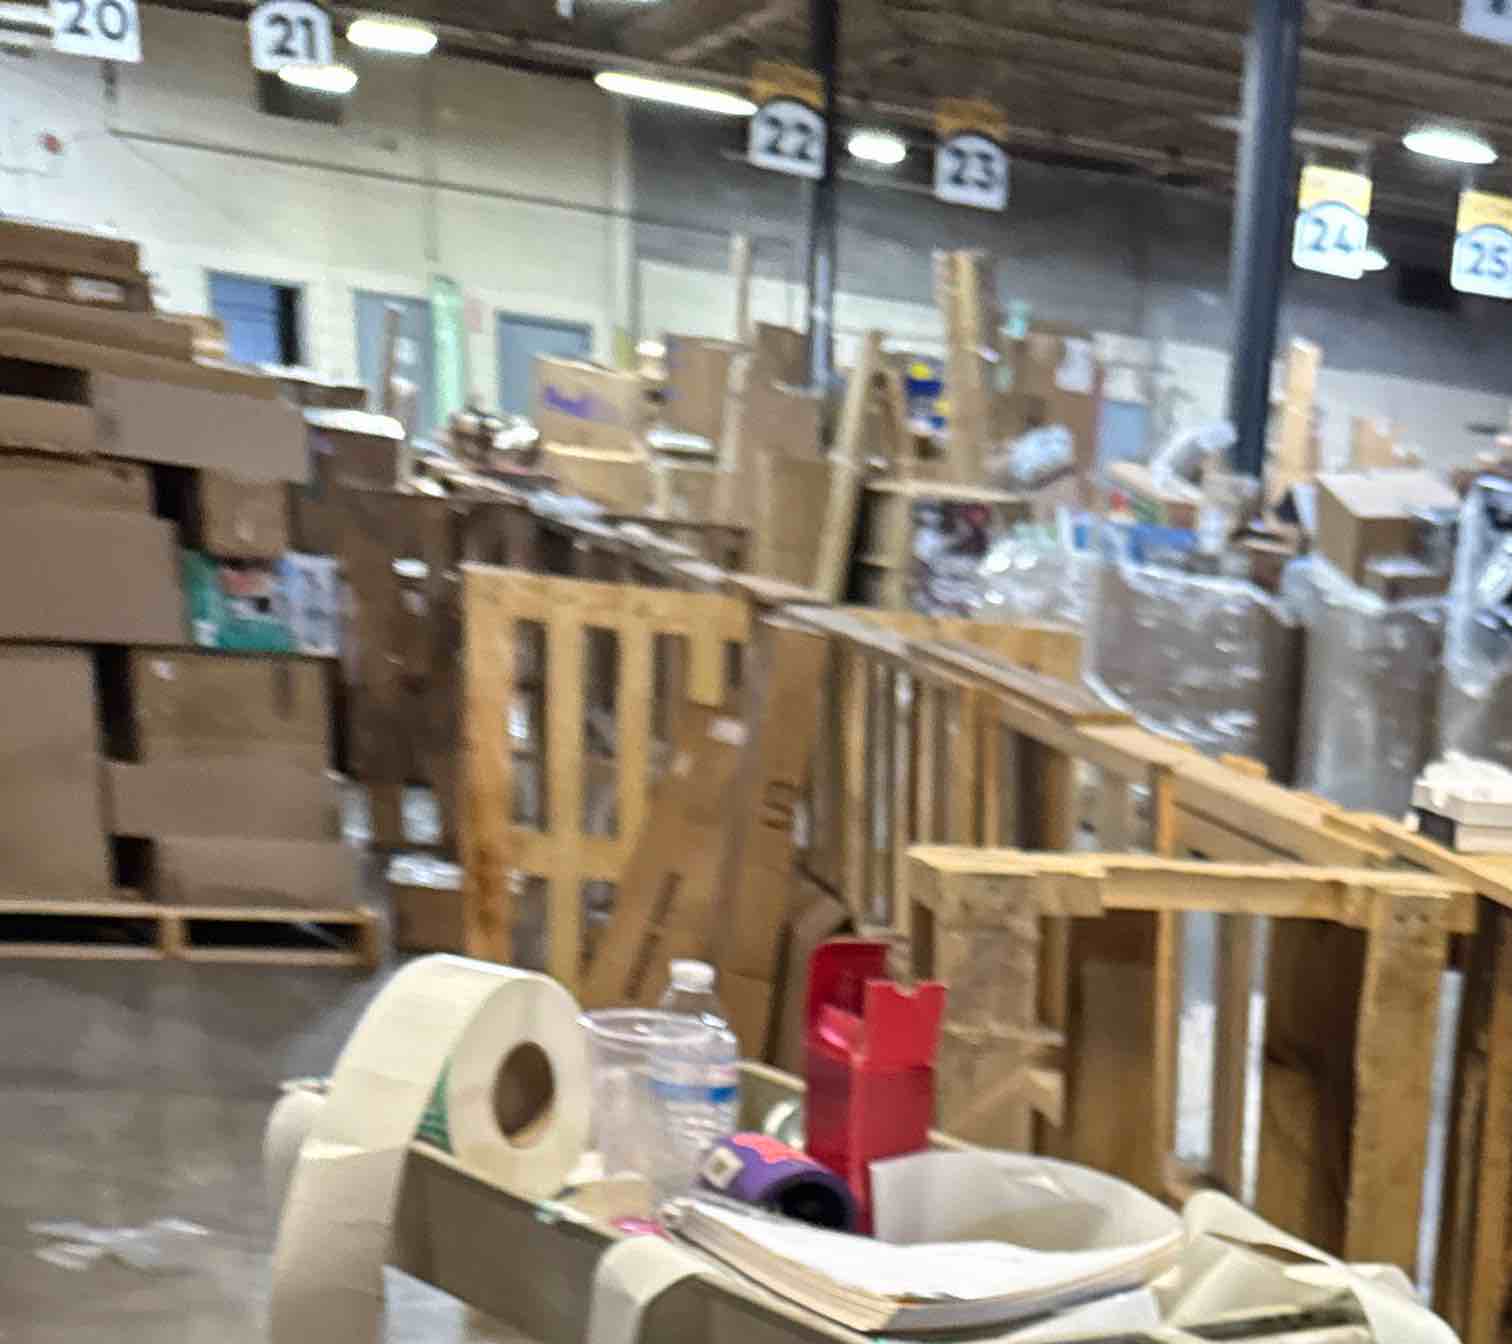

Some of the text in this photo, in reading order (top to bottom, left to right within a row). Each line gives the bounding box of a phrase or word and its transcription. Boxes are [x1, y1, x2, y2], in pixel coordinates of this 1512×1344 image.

[57, 0, 129, 40] 20
[268, 14, 318, 60] 21
[764, 114, 817, 161] 22
[949, 146, 997, 190] 23
[1304, 215, 1355, 254] 24
[1468, 241, 1509, 280] 25
